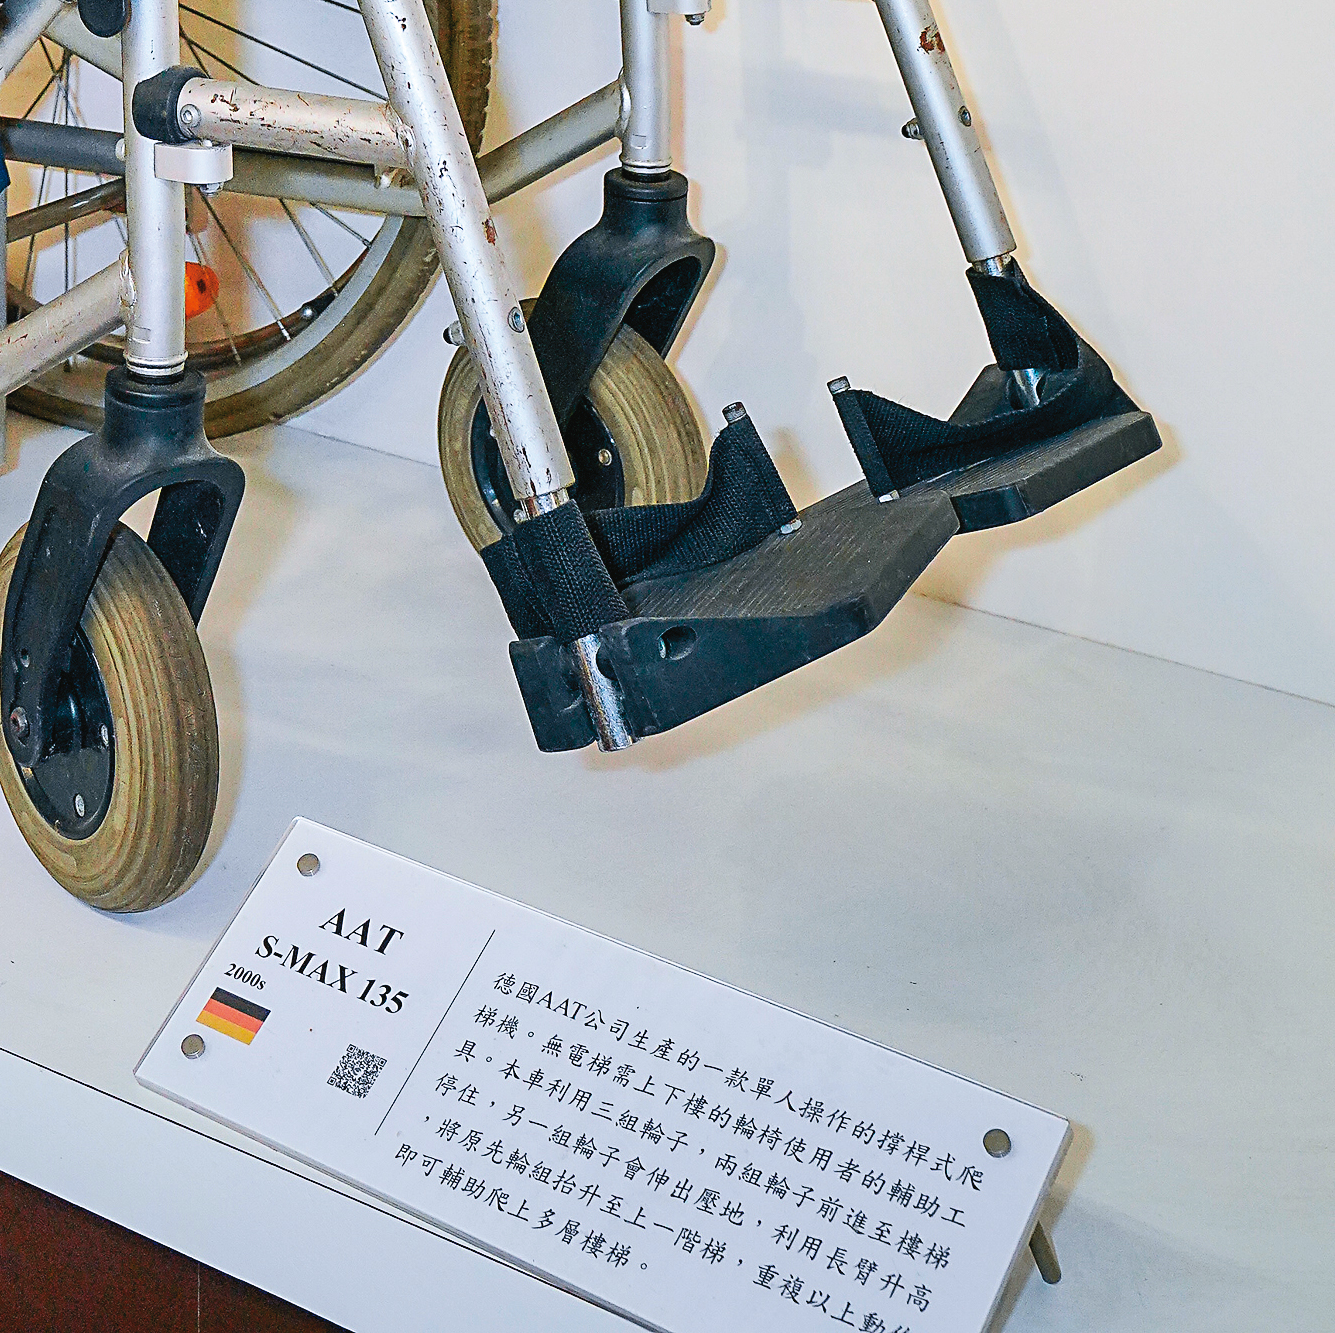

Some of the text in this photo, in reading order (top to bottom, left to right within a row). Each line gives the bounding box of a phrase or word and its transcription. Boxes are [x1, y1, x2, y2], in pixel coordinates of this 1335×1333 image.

[318, 907, 406, 956] AAT
[223, 962, 267, 991] 2000s
[254, 935, 411, 1015] S-MAX 135
[393, 1142, 649, 1271] 即可輔助爬上多層樓梯。
[423, 1114, 911, 1333] ，將原先輪組抬升至上一階梯，重複以上動
